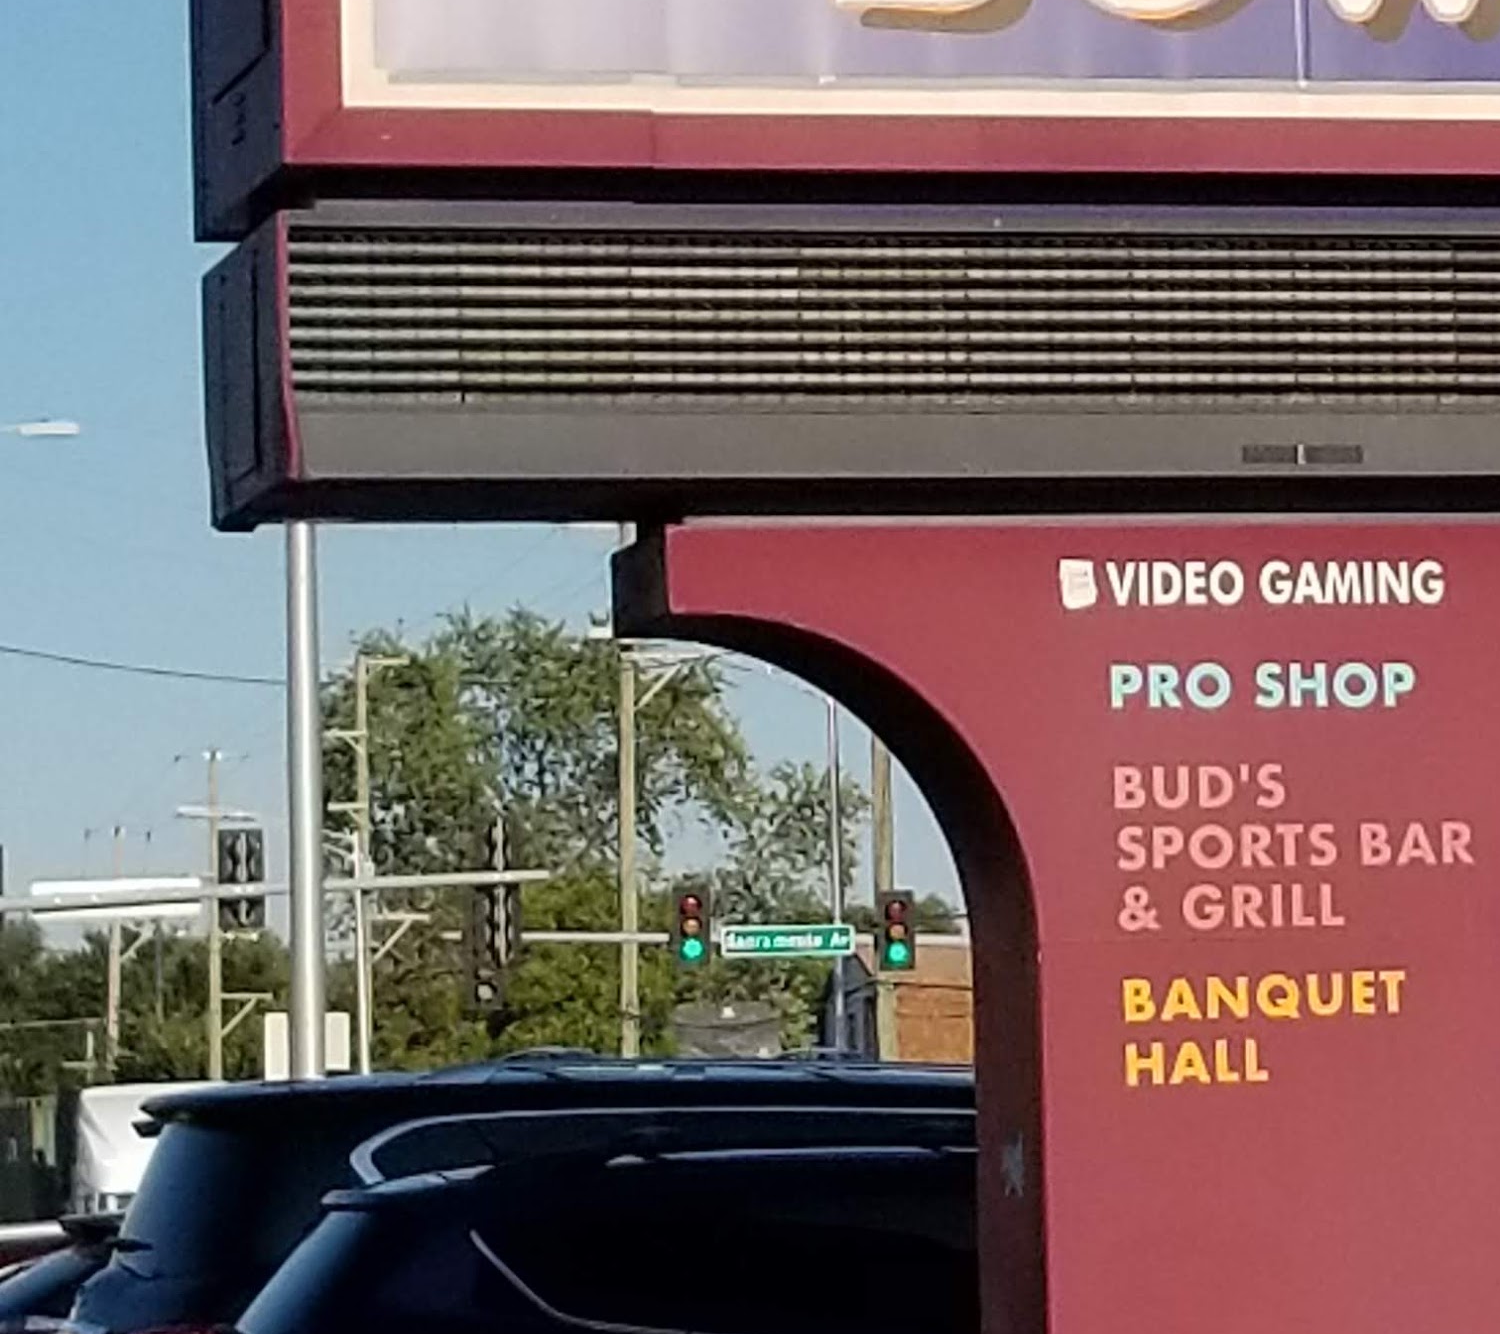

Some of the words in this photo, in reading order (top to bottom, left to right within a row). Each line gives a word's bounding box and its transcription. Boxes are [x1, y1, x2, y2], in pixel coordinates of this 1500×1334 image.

[1106, 560, 1245, 606] VIDEO
[1258, 559, 1445, 605] GAMING
[1109, 662, 1232, 709] PRO
[1254, 662, 1417, 708] SHOP
[1113, 763, 1286, 809] BUD'S
[1116, 823, 1338, 869] SPORTS
[1359, 821, 1475, 866] BAR
[1117, 885, 1160, 931] &
[1181, 883, 1346, 929] GRILL
[1122, 970, 1406, 1023] BANQUET
[1124, 1038, 1269, 1087] HALL
